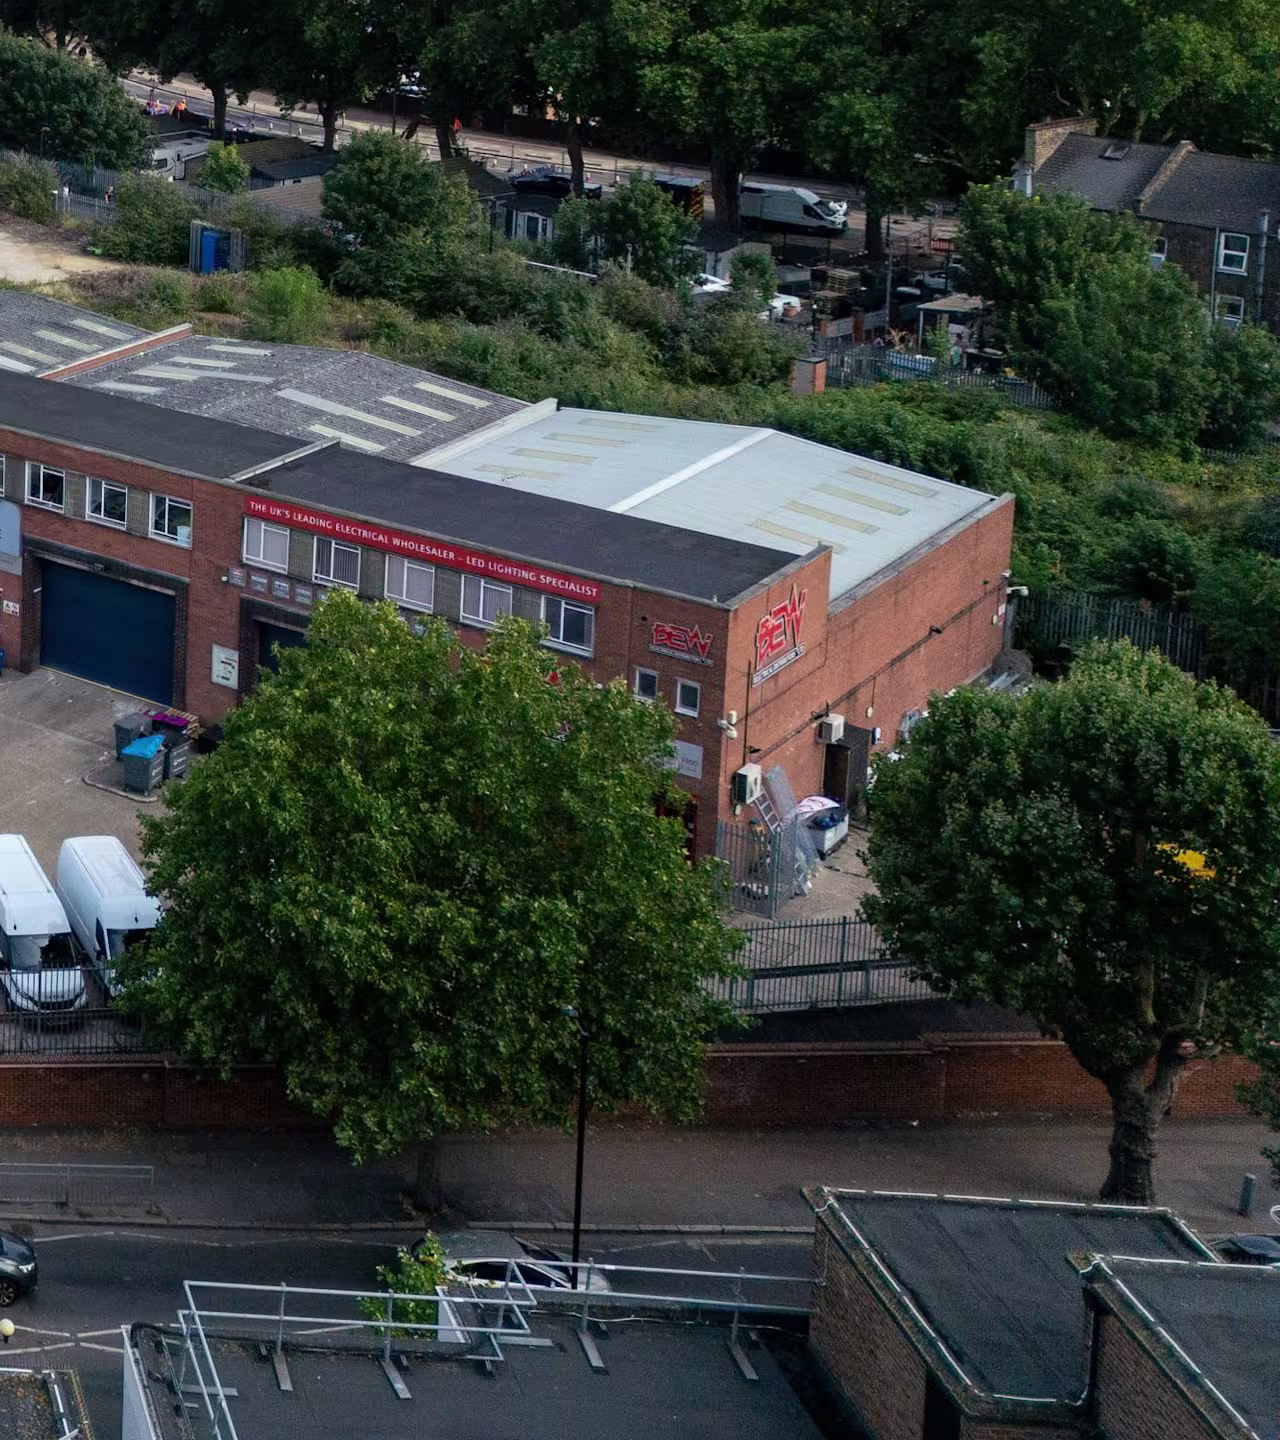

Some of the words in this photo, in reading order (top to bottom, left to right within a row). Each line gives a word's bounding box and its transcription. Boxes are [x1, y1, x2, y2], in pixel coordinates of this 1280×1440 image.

[250, 501, 267, 513] THE
[269, 505, 290, 518] UK'S
[292, 512, 333, 529] LEADING
[335, 523, 389, 544] ELECTRICAL
[392, 538, 456, 561] WHOLESALER
[466, 556, 485, 568] LED
[488, 561, 537, 581] LIGHTING
[540, 574, 598, 597] SPECIALIST
[653, 622, 714, 661] BEW
[756, 584, 808, 671] BEW
